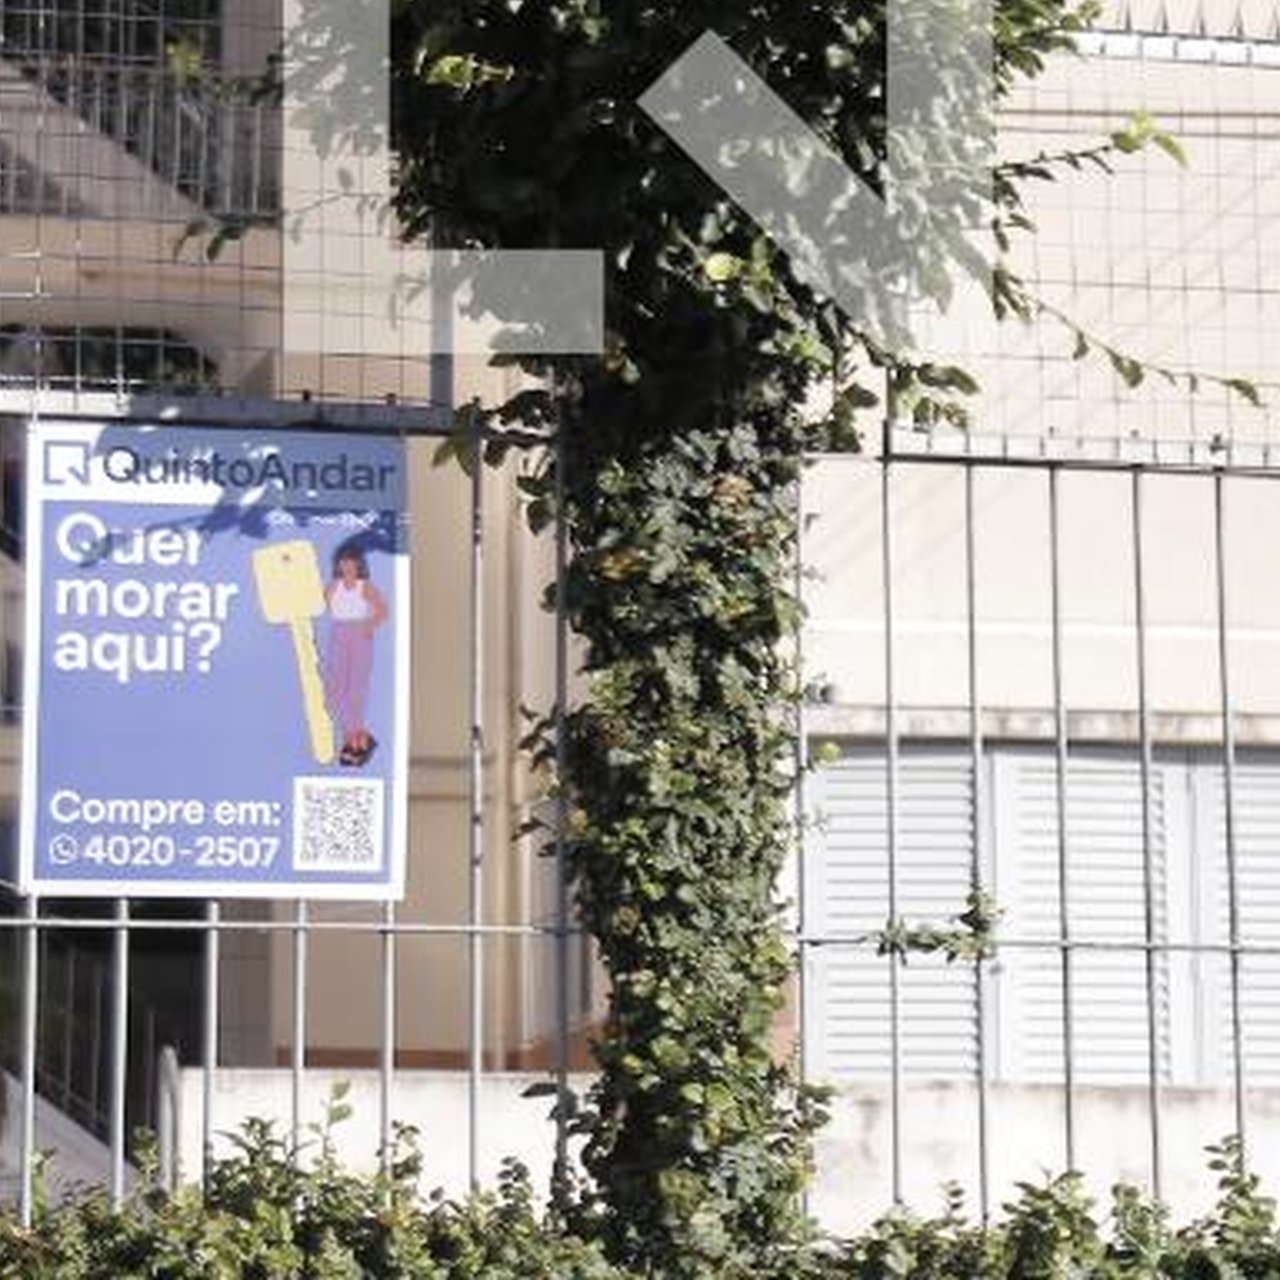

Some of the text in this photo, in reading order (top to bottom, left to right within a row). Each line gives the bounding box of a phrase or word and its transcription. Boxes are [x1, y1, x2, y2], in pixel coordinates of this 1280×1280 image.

[102, 445, 397, 492] QuintoAndar
[56, 512, 203, 567] Quer
[54, 578, 239, 621] morar
[53, 622, 223, 683] aqui?
[49, 789, 283, 830] Compre em:
[83, 834, 282, 867] 4020-2507
